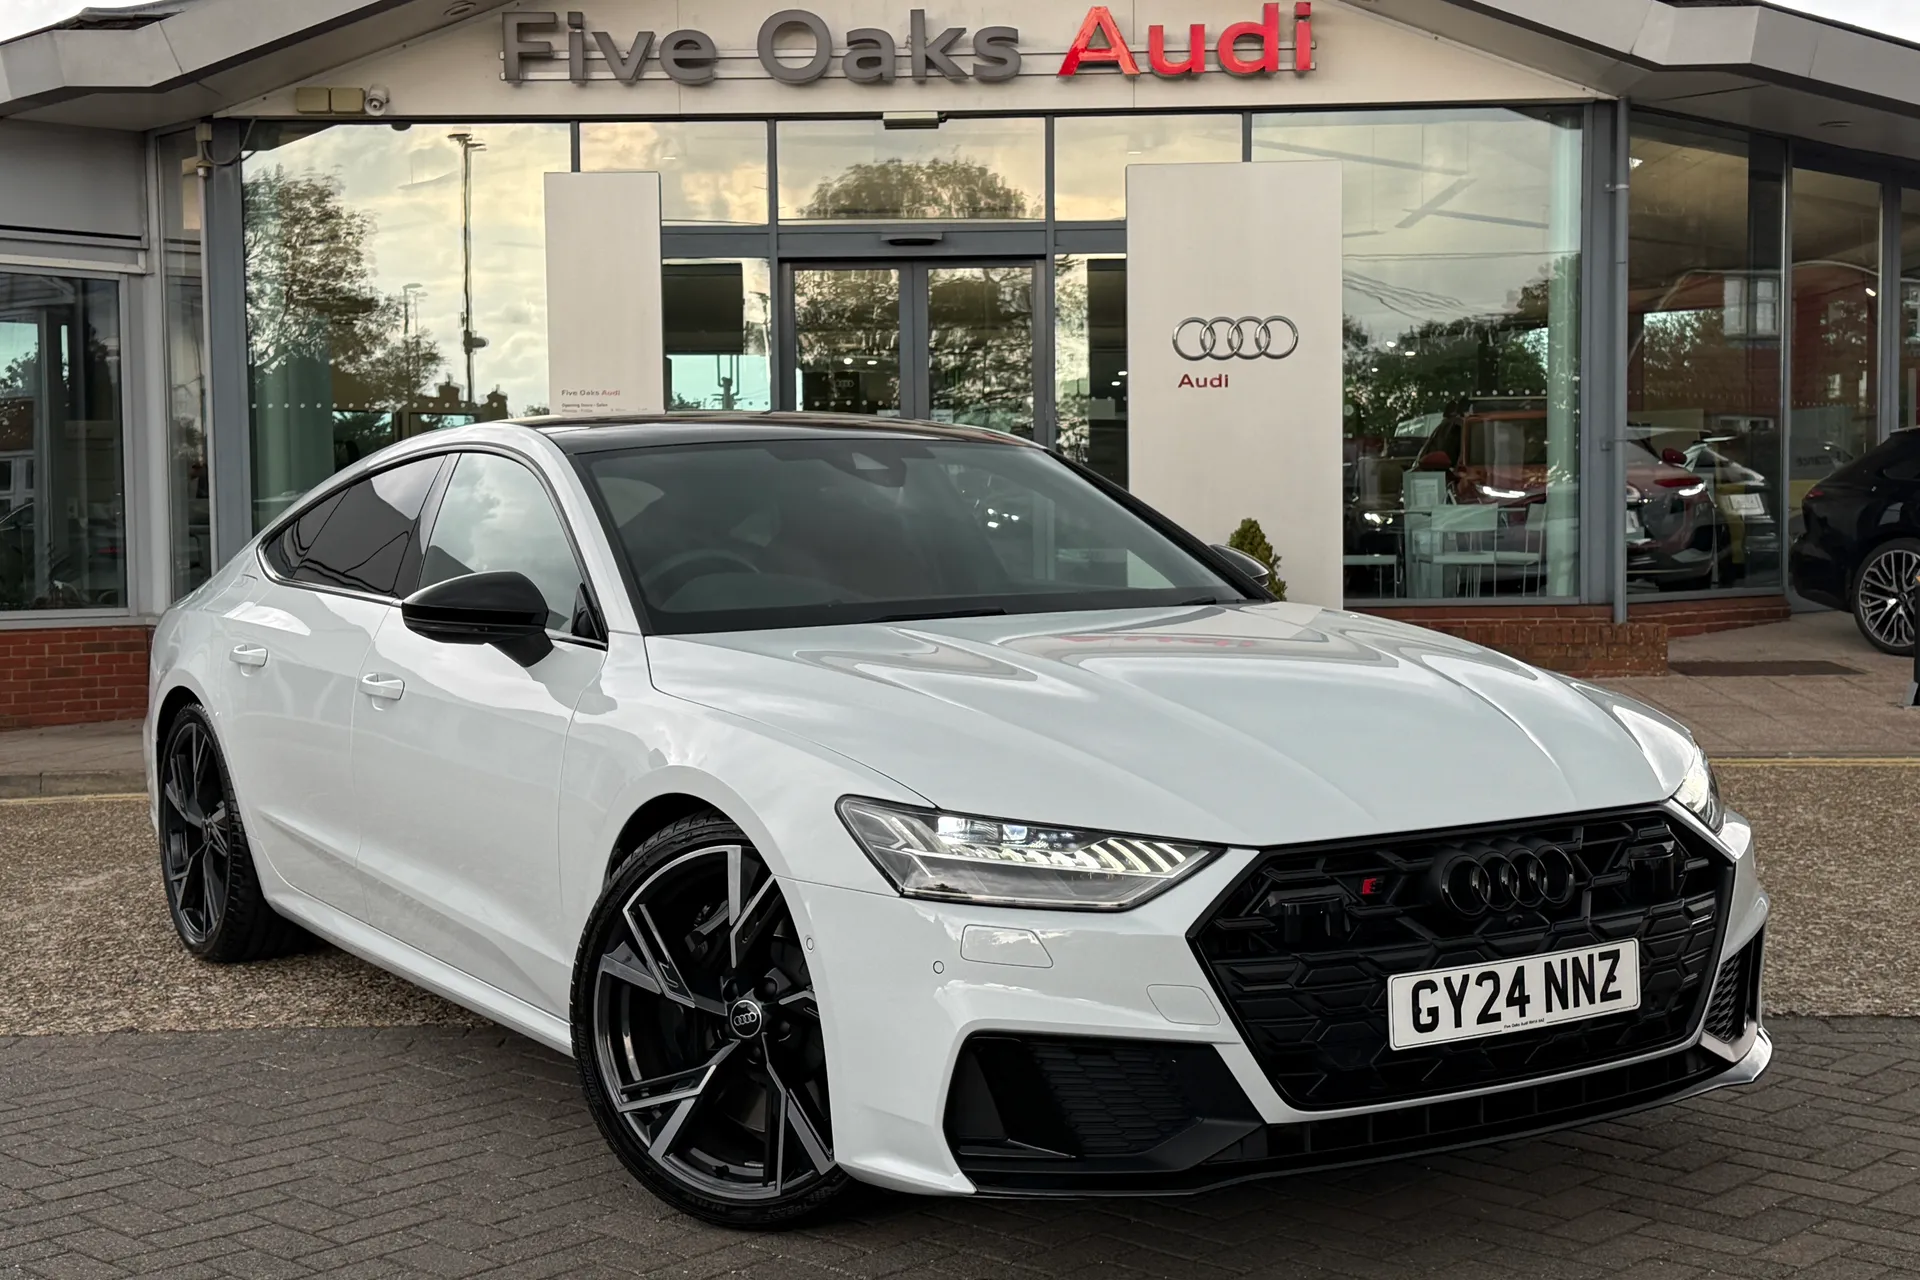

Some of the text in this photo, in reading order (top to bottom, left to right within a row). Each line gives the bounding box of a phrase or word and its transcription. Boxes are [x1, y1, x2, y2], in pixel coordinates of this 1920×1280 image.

[502, 2, 1312, 85] Five Oaks Audi
[1178, 374, 1229, 388] Audi
[1411, 948, 1622, 1034] GY24 NNZ
